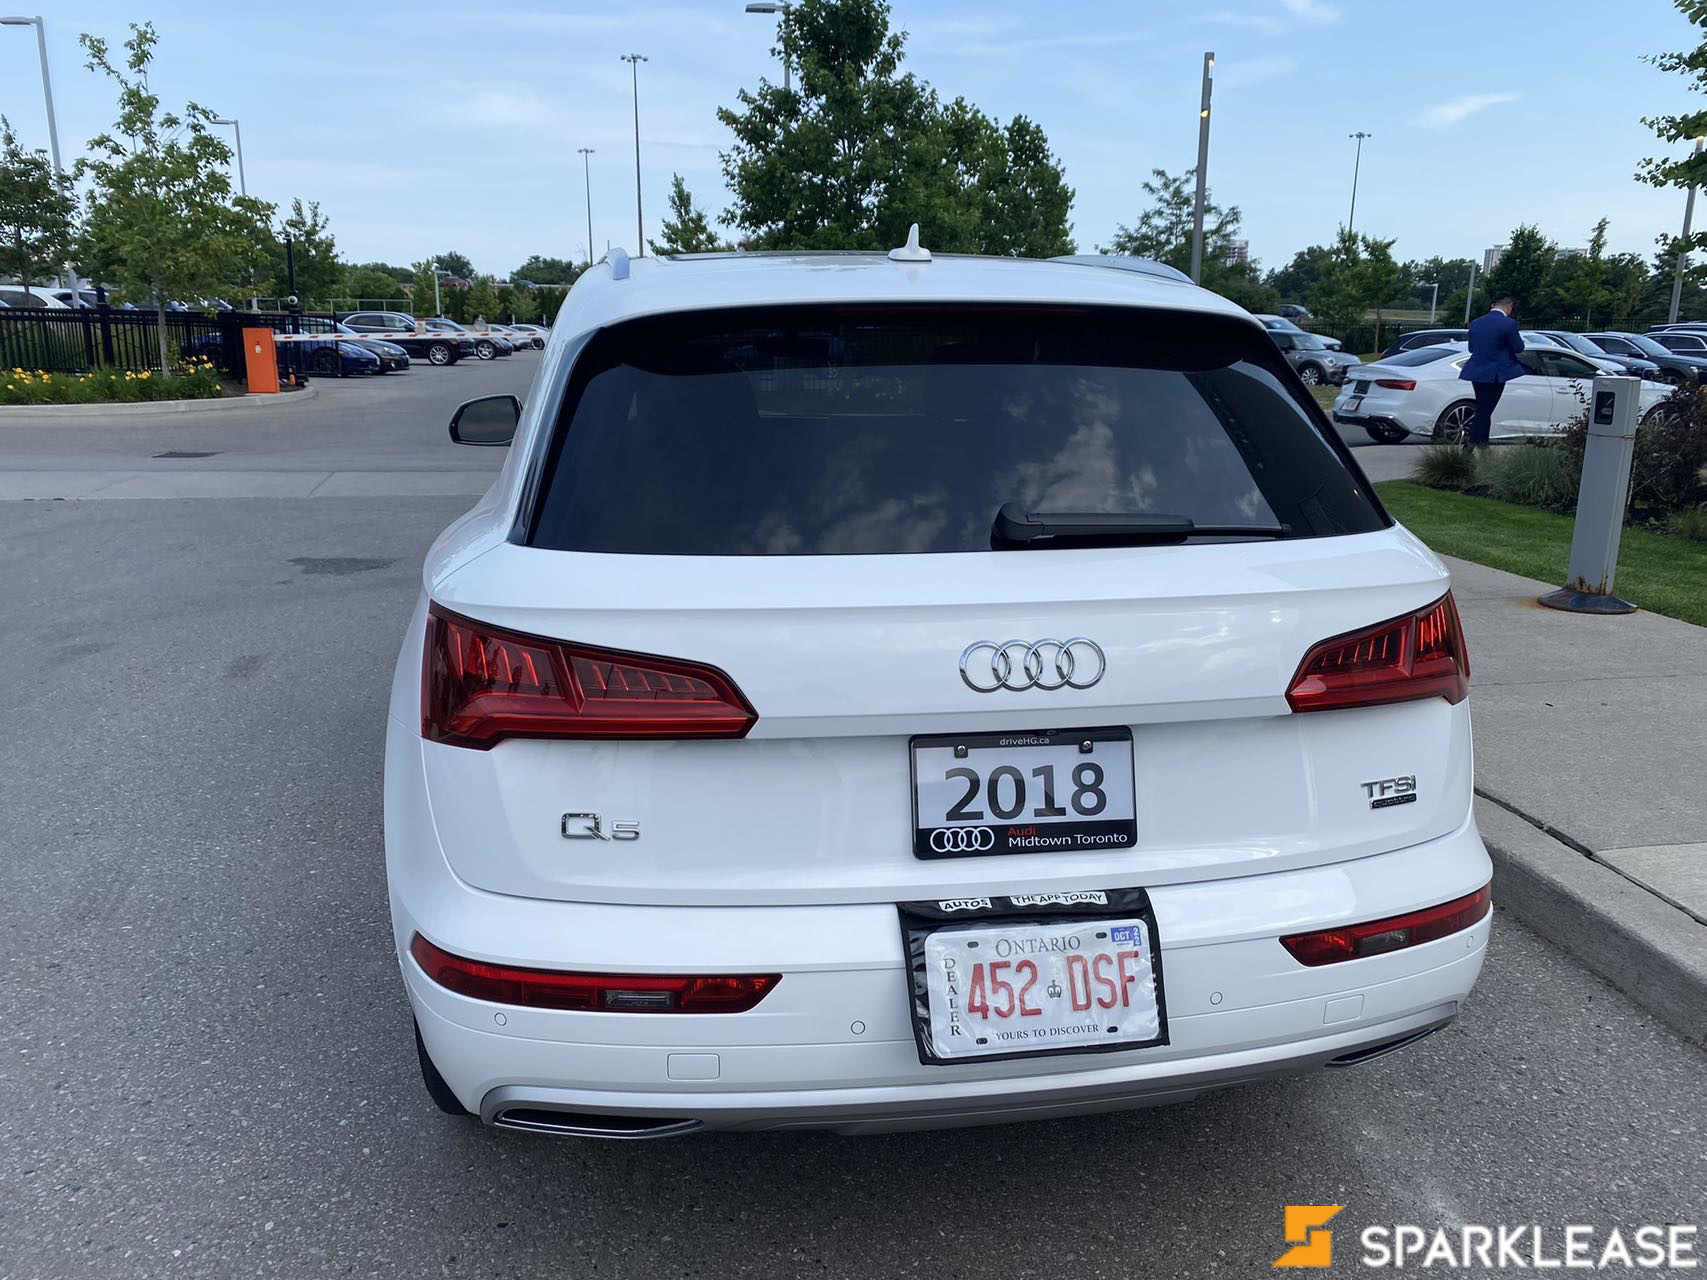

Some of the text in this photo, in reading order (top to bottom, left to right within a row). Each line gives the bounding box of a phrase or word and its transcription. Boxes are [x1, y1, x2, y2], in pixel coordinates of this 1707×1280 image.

[945, 762, 1107, 821] 2018
[561, 812, 640, 841] Q5
[1008, 826, 1039, 837] Audi
[1008, 833, 1128, 848] Midtown Toronto
[995, 935, 1081, 958] ONTARIO
[1114, 931, 1130, 941] OCT
[967, 950, 1140, 1020] 452 DSF
[944, 958, 961, 1037] DEALER
[995, 1024, 1099, 1041] YOURS TO DISCOVER
